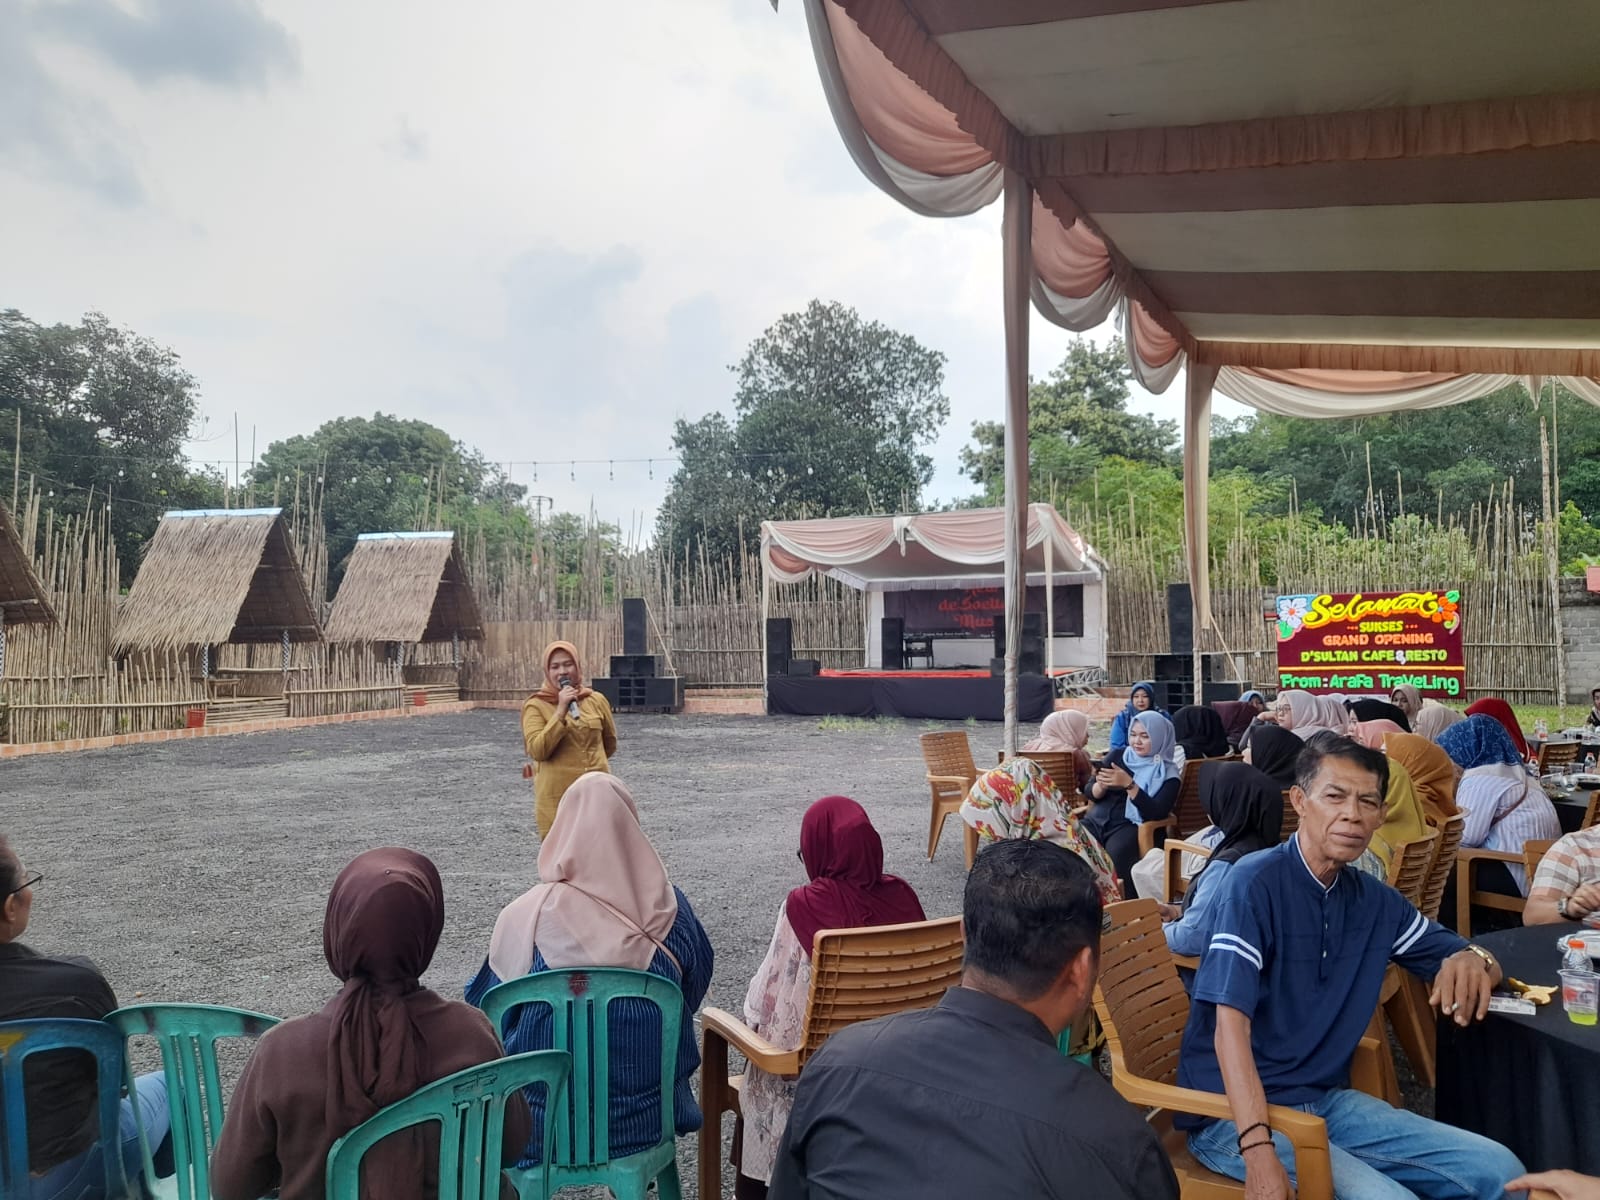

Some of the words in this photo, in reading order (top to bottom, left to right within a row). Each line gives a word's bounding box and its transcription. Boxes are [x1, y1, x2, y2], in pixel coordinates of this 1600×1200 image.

[1302, 592, 1438, 628] Selamat
[1359, 621, 1404, 633] SUKSES
[1322, 635, 1369, 646] GRAND
[1374, 633, 1434, 645] OPENING
[1301, 651, 1358, 662] D'SULTAN
